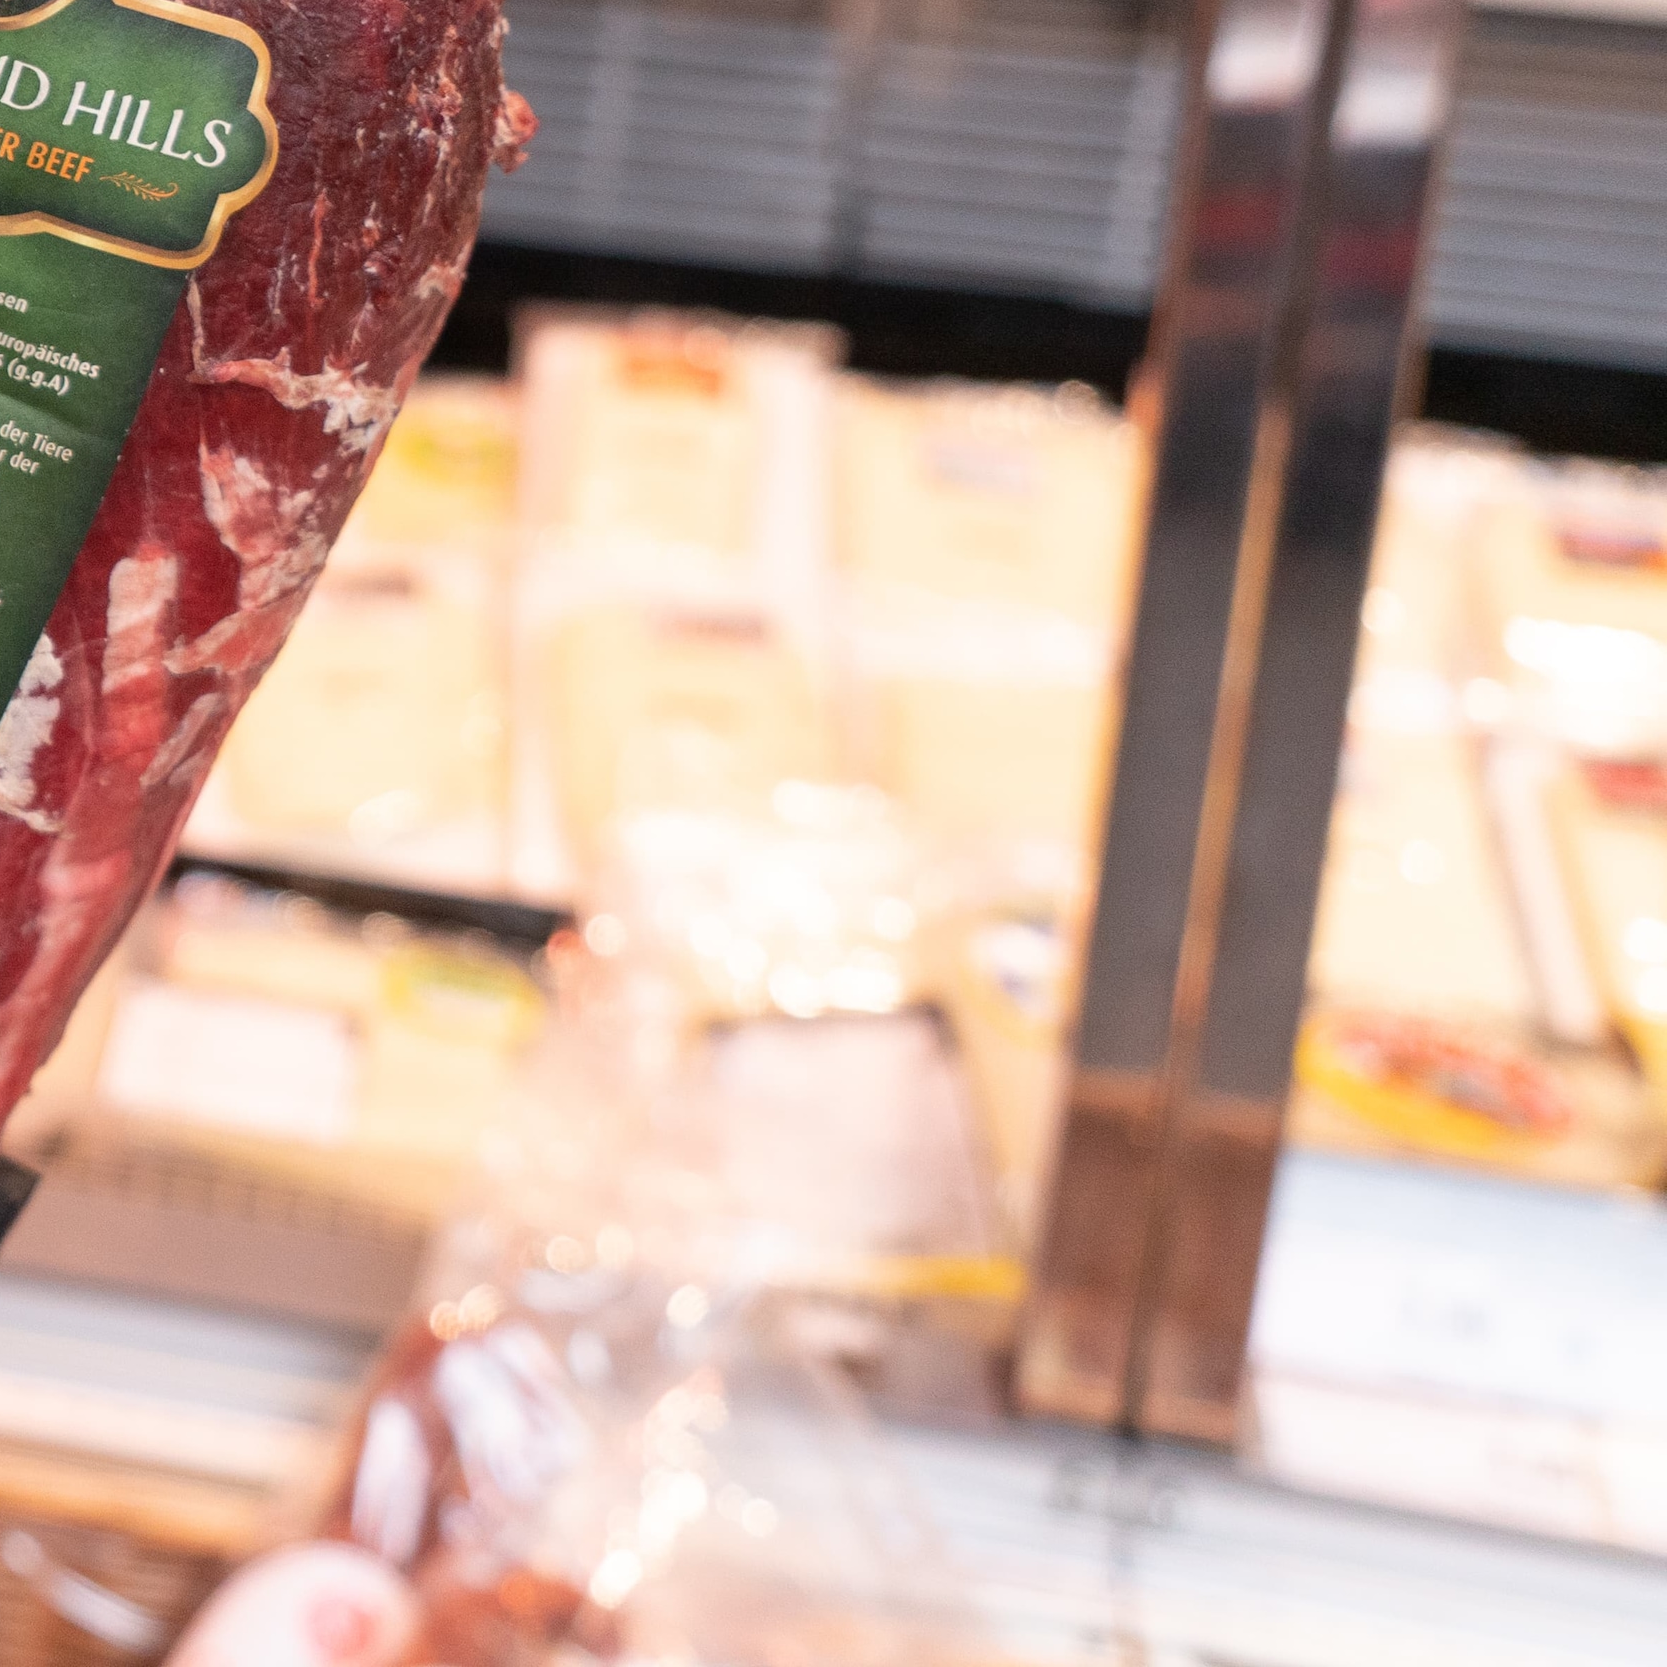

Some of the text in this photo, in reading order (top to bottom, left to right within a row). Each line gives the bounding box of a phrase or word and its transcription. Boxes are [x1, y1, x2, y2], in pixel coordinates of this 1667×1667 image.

[62, 81, 232, 168] HILLS
[26, 141, 95, 183] BEEF
[7, 357, 70, 396] (g.g.A)
[0, 419, 29, 445] der
[32, 432, 73, 463] Tiere
[9, 451, 40, 475] der
